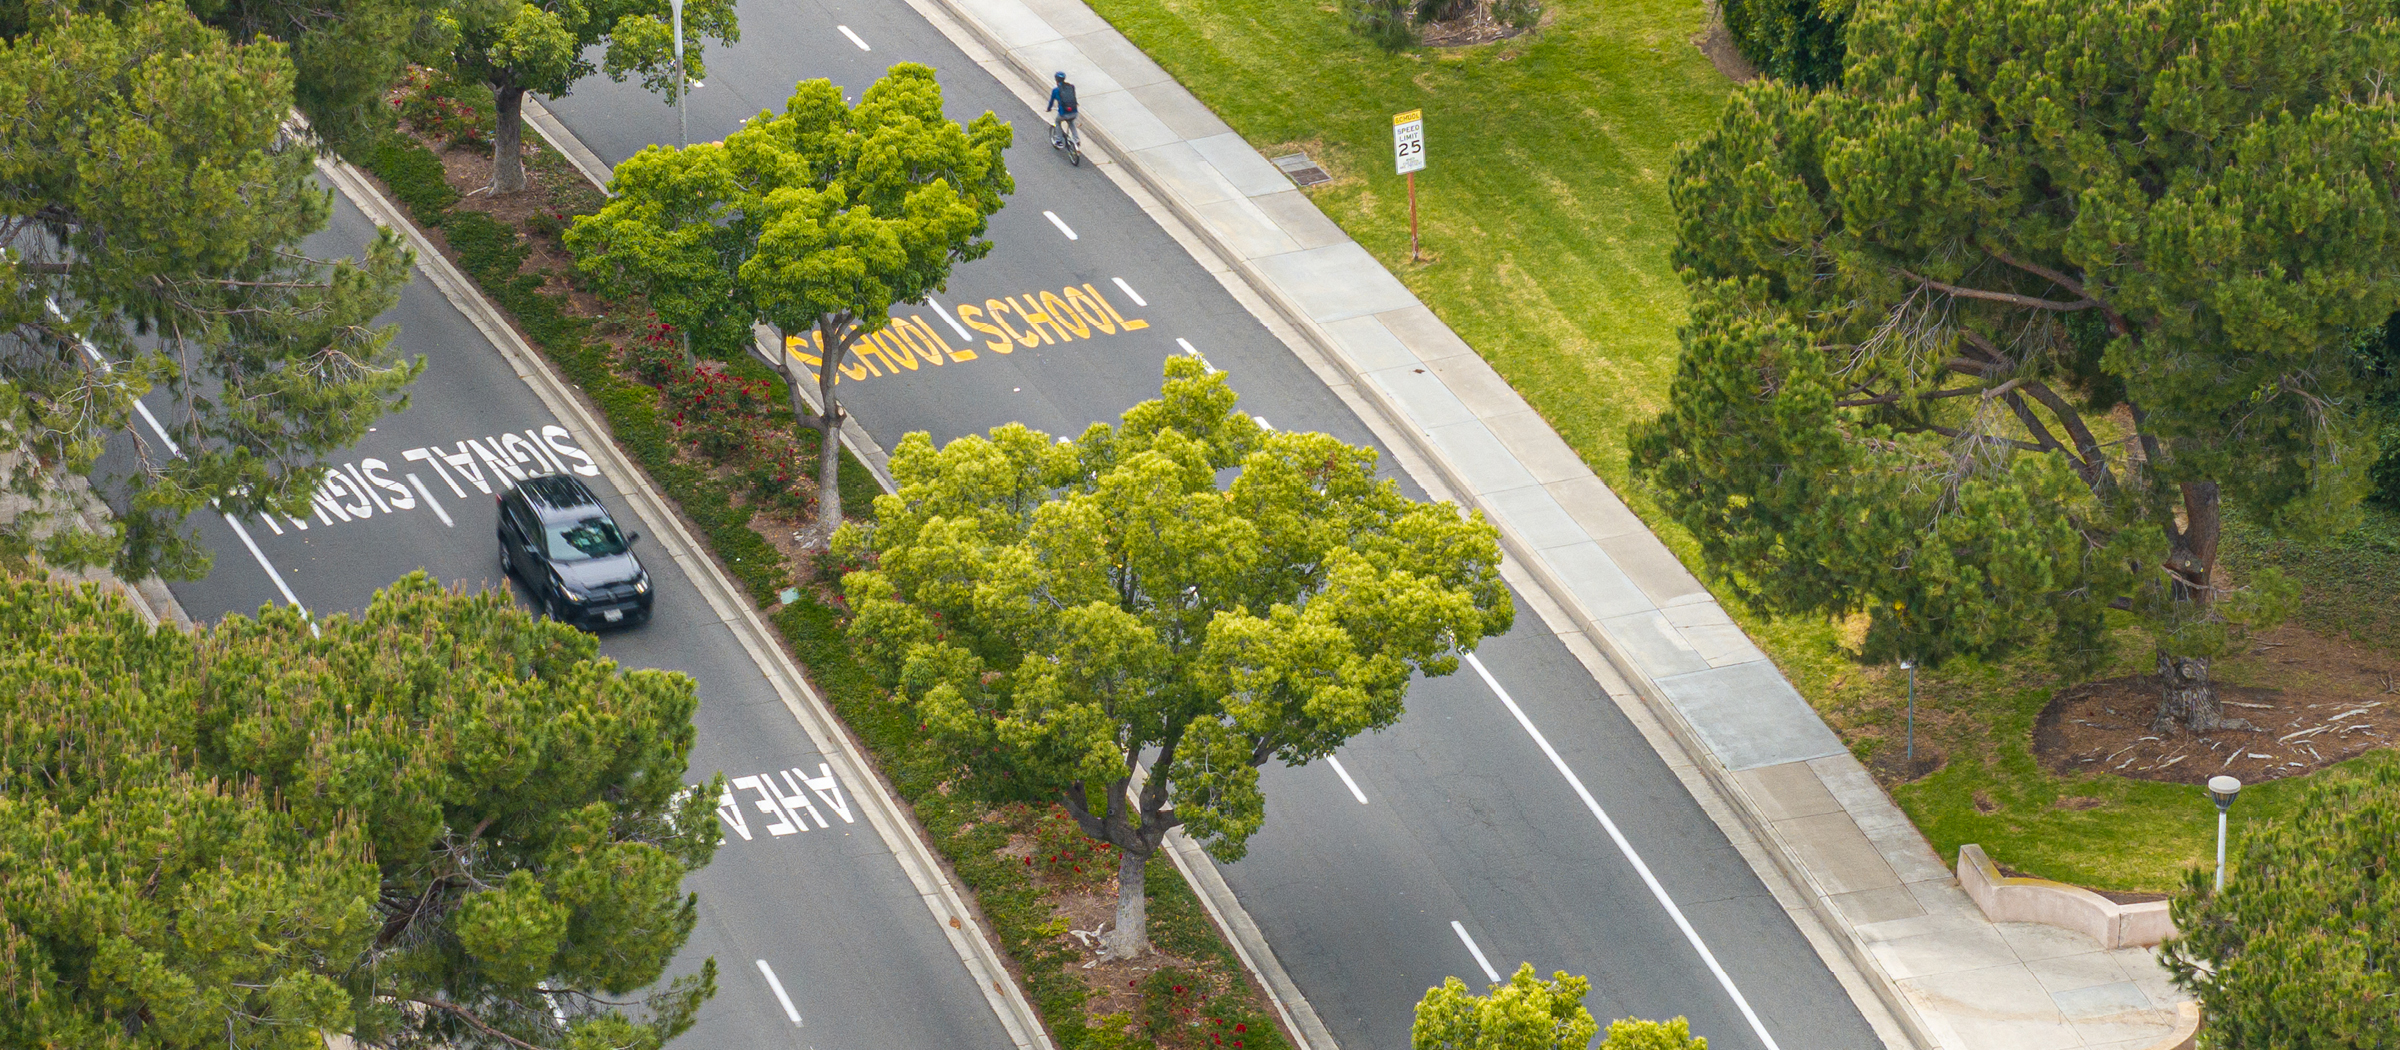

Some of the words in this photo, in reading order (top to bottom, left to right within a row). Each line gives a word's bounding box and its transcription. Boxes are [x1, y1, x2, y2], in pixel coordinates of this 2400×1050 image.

[1397, 124, 1420, 135] SPEED
[1400, 132, 1418, 142] LIMIT
[1398, 139, 1421, 157] 25
[957, 283, 1150, 354] SCHOOL
[402, 425, 601, 499] SIGNAL
